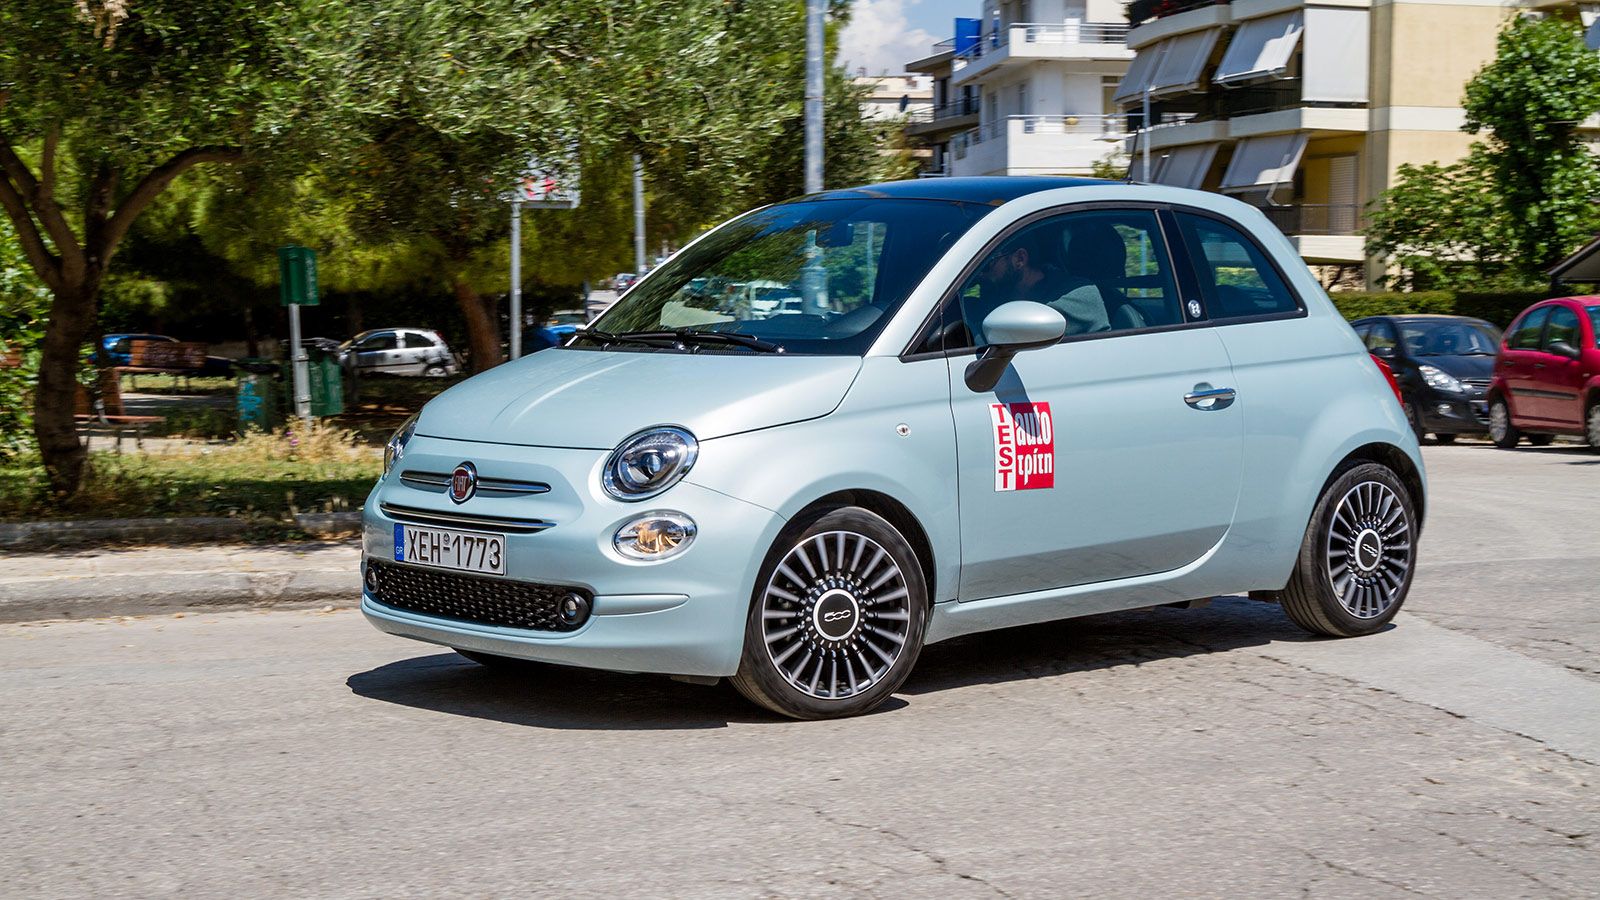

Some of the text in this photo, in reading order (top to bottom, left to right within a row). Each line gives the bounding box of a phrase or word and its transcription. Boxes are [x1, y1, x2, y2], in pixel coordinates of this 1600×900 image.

[1014, 405, 1052, 446] auto
[992, 404, 1013, 489] TEST
[454, 475, 468, 492] FIAT
[1016, 447, 1053, 486] τρίτη
[395, 546, 404, 555] GR
